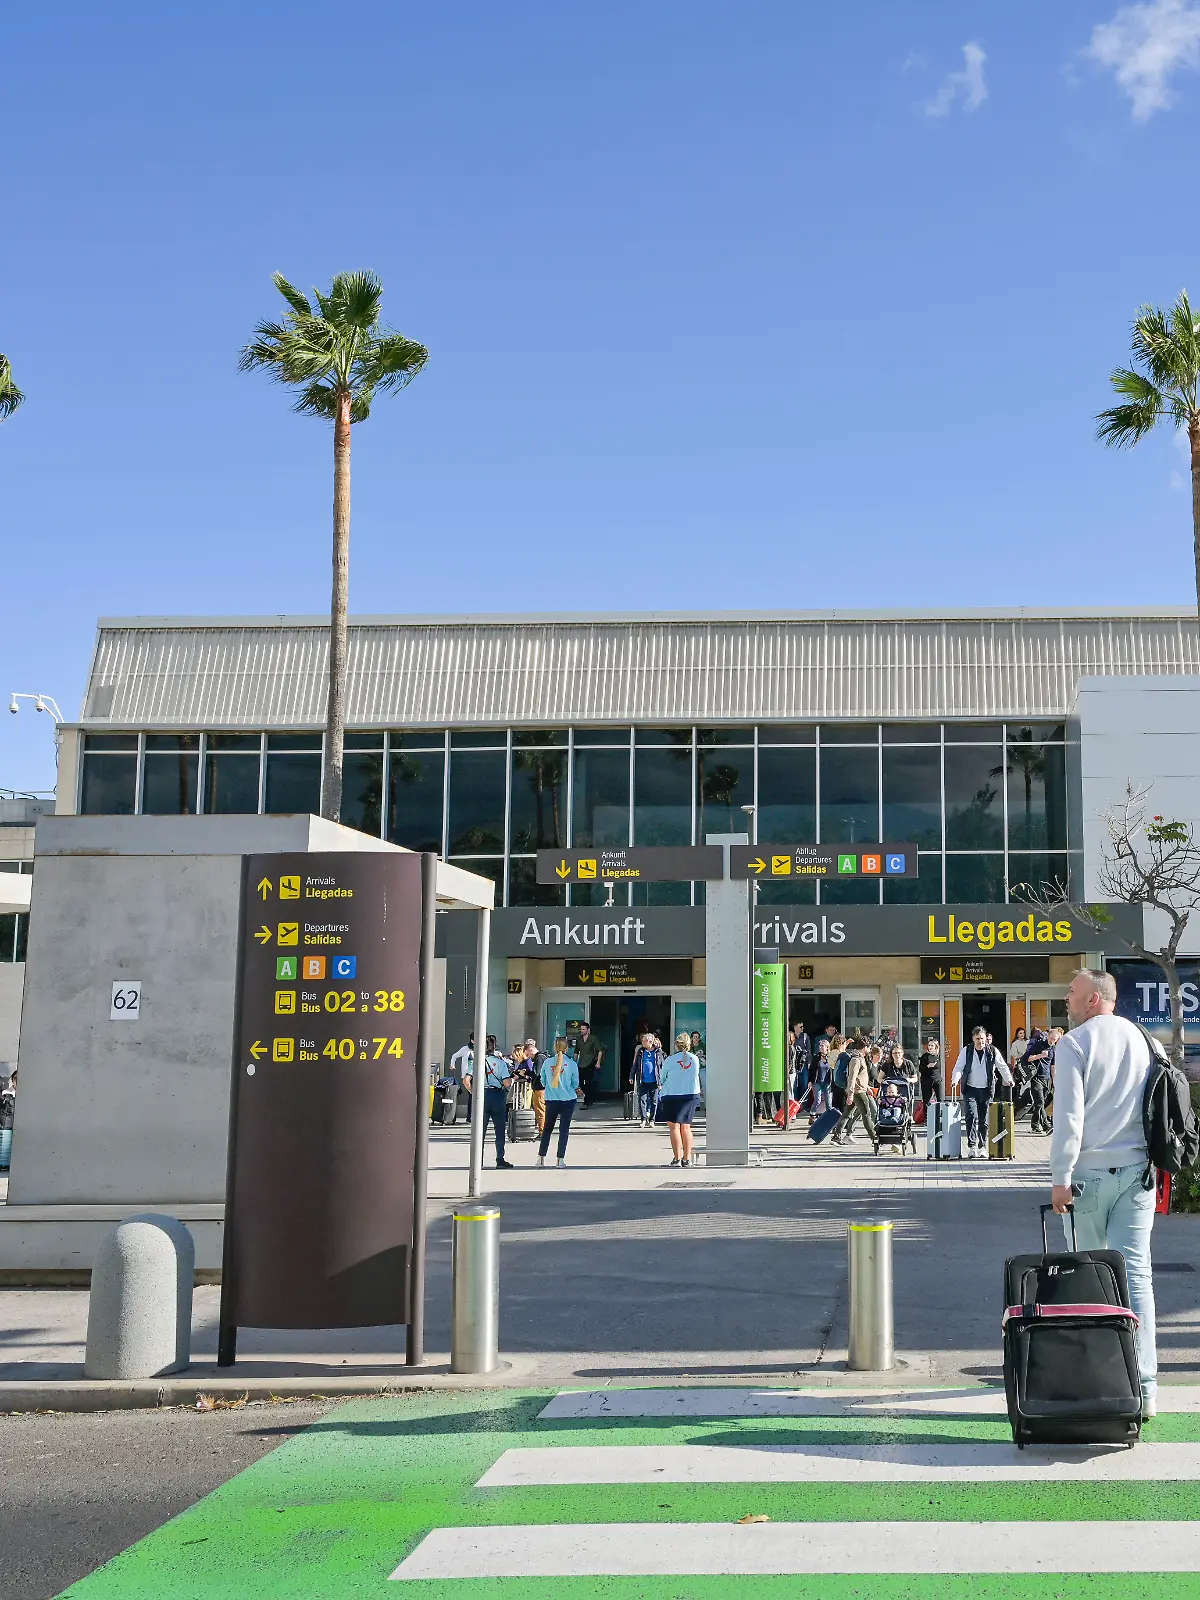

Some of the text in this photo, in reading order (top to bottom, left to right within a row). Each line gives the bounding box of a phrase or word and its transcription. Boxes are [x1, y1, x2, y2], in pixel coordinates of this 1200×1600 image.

[795, 856, 833, 864] Departures
[795, 858, 900, 874] Salidas A B C
[601, 868, 641, 879] Llegadas
[305, 876, 336, 885] Arrivals
[305, 888, 353, 900] Llegadas
[304, 923, 349, 933] Departures
[520, 916, 645, 945] Ankunft
[928, 914, 1073, 950] Llegadas
[304, 934, 342, 944] Salidas
[280, 960, 350, 976] A B C
[800, 968, 811, 977] 16
[610, 976, 637, 984] Llegadas
[509, 981, 520, 992] 17
[114, 989, 139, 1010] 62
[301, 990, 405, 1013] Bus 02 a 38
[302, 992, 370, 1000] Bus to
[1136, 982, 1199, 1012] TFS
[761, 984, 771, 1083] Hallo! ¡Hola! Hello!
[300, 1039, 368, 1048] Bus to
[299, 1038, 404, 1061] Bus 40 a 74
